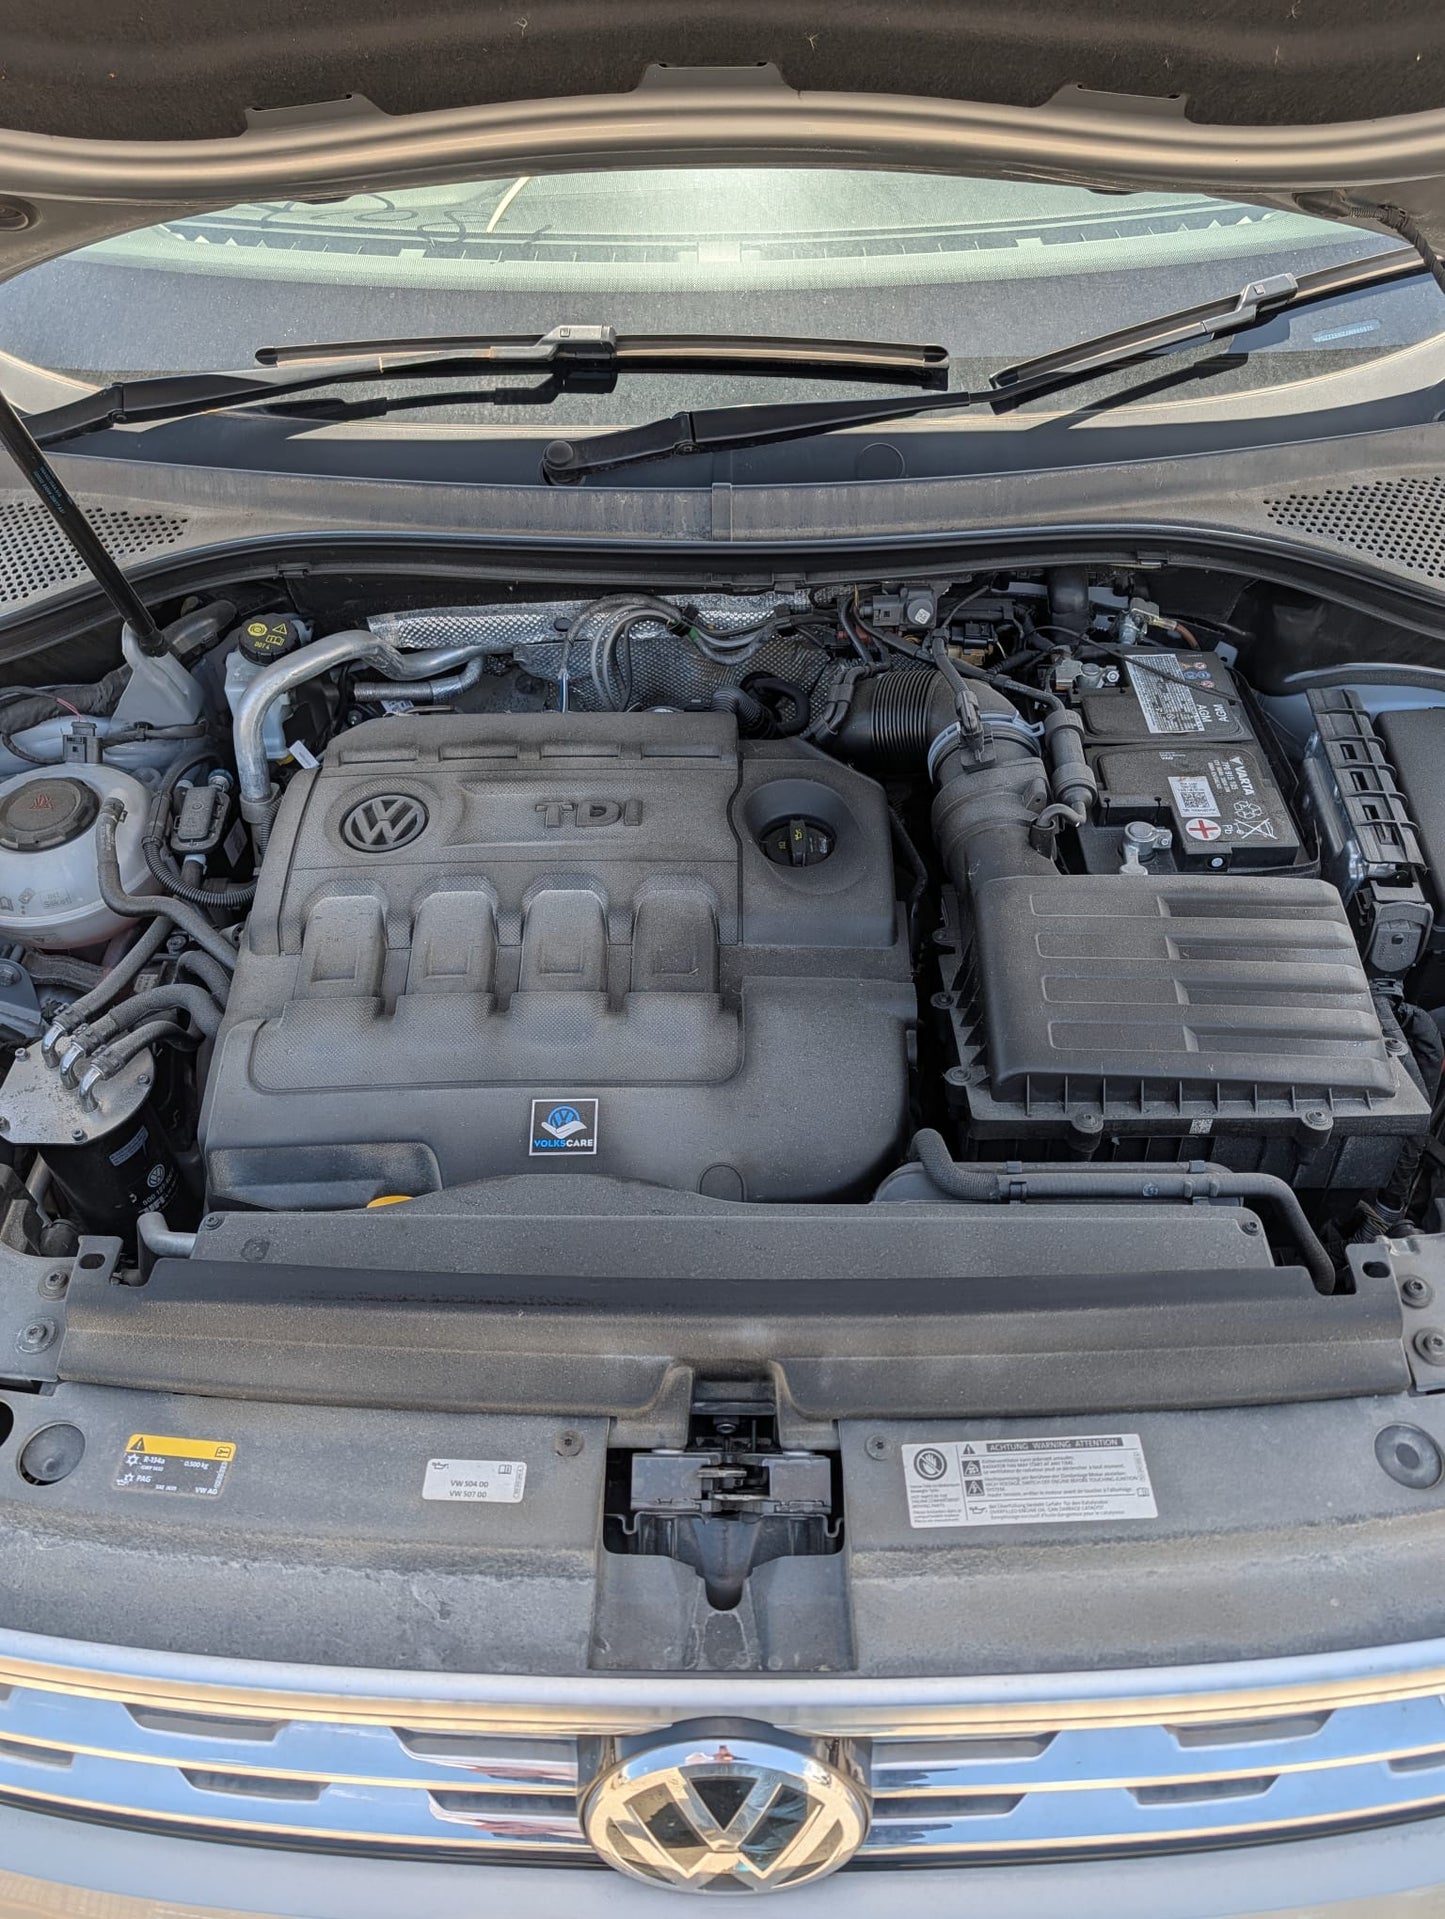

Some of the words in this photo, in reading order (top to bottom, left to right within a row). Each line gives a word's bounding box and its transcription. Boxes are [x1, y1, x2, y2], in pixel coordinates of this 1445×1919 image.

[1196, 704, 1212, 722] AGM
[1213, 704, 1230, 722] AGM
[1234, 766, 1255, 796] VARTA
[535, 798, 643, 828] TDI
[534, 1139, 593, 1147] VOLKSCARE
[1032, 1441, 1071, 1449] WARNING
[1075, 1438, 1117, 1447] ATTENTION
